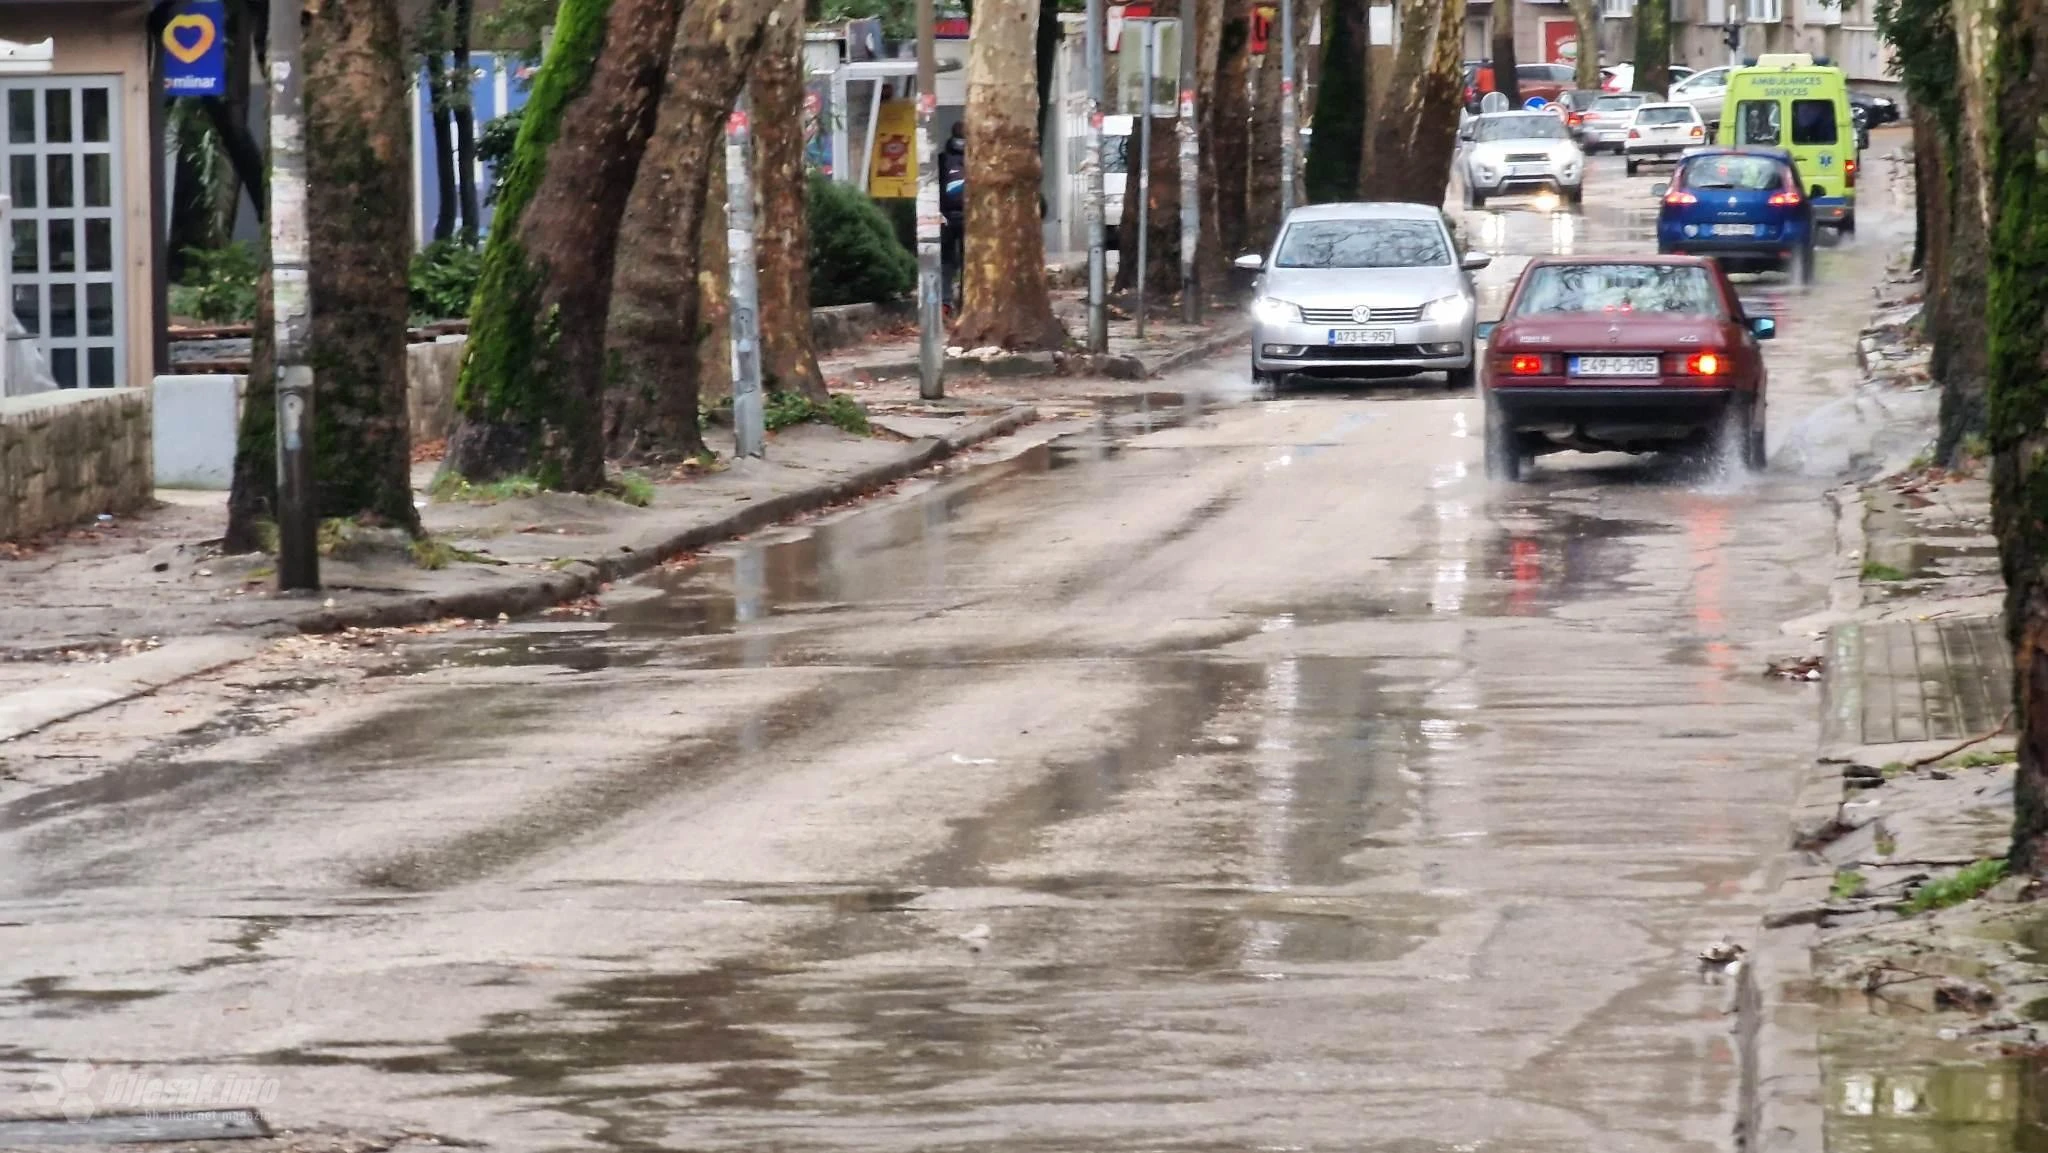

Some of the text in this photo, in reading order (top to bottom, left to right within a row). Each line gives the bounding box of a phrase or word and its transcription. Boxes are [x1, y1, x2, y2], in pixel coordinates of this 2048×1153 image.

[1751, 77, 1822, 85] AMBULANCES
[1765, 88, 1808, 96] SERVICES
[1337, 331, 1392, 342] A73-E-957
